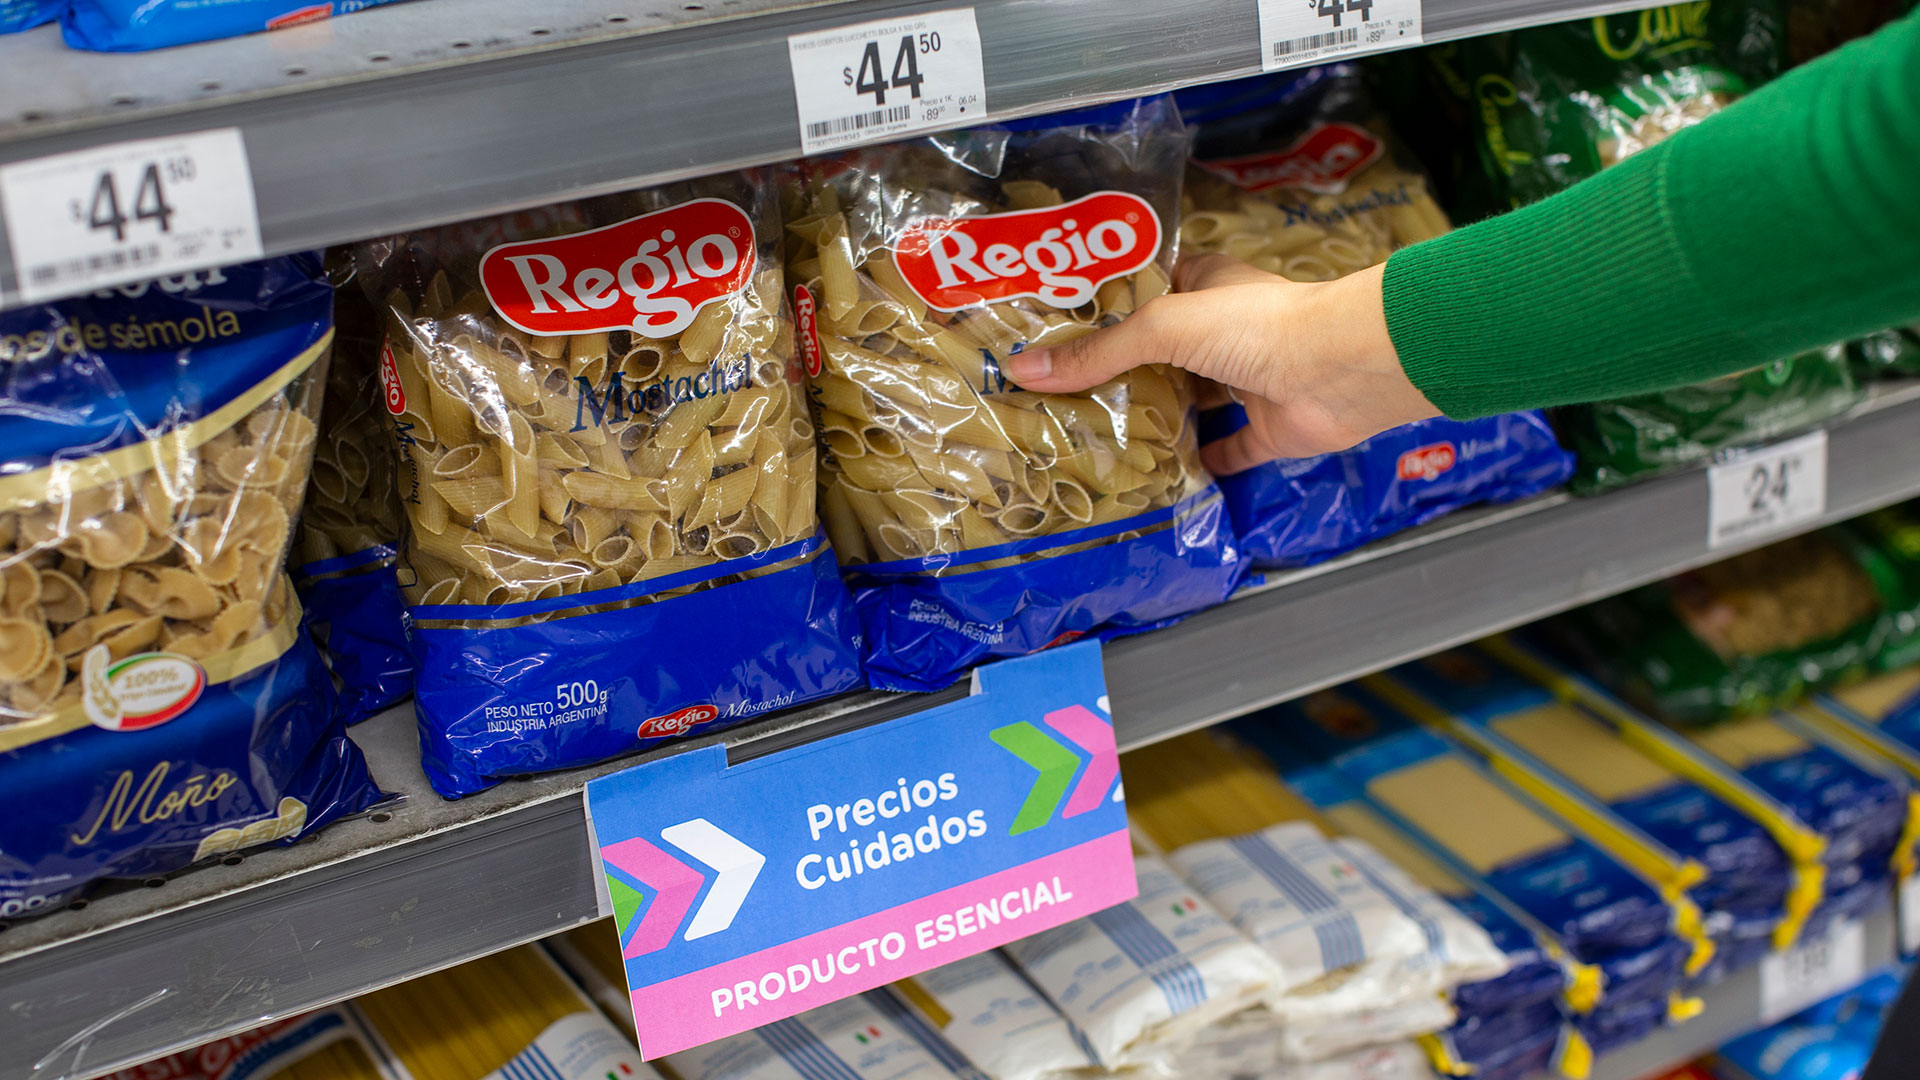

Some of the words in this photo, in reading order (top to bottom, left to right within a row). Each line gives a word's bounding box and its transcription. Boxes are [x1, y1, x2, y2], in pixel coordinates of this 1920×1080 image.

[920, 98, 938, 107] Precio
[959, 95, 977, 105] 06.04
[504, 229, 738, 336] Regio
[925, 219, 1137, 308] Regio
[55, 315, 107, 353] de
[110, 305, 241, 349] sémola
[798, 298, 816, 369] Regio
[381, 347, 399, 406] egio
[568, 354, 752, 432] Mostachol
[485, 705, 518, 719] PESO
[521, 701, 553, 717] NETO
[557, 680, 607, 709] 500g
[487, 718, 547, 733] INDUSTRIA
[549, 703, 608, 728] ARGENTINA
[649, 708, 712, 736] Regio
[722, 690, 794, 719] Mostachol
[71, 761, 237, 846] Moño
[805, 772, 959, 841] Precios
[795, 808, 987, 891] Cuidados
[710, 930, 906, 1018] PRODUCTO
[915, 875, 1073, 951] ESENCIAL
